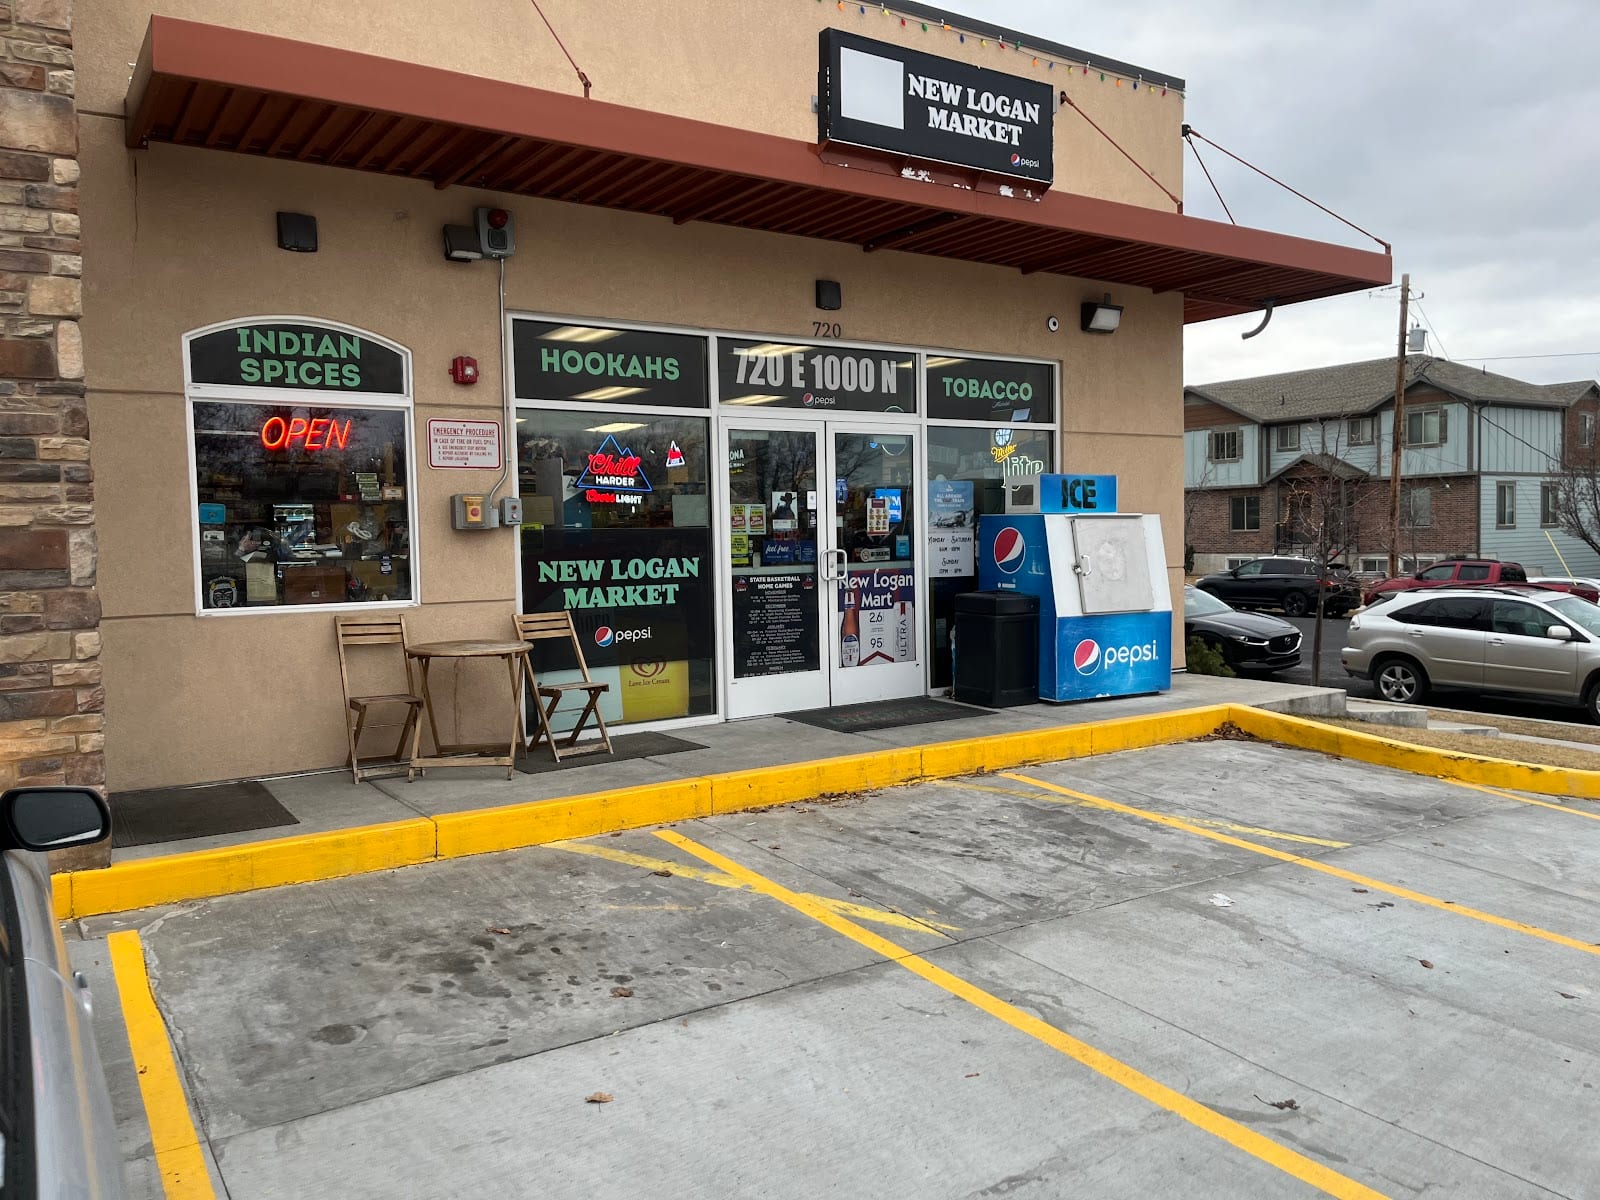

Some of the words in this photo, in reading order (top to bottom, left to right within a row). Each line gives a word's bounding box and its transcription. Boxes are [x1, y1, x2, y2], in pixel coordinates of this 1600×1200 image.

[908, 73, 963, 106] NEW
[966, 87, 1041, 125] LOGAN
[927, 106, 1023, 147] MARKET
[1020, 158, 1040, 169] pepsi
[812, 322, 842, 338] 720
[236, 327, 361, 360] INDIAN
[240, 357, 361, 388] SPICES
[541, 348, 680, 381] HOOKAHS
[733, 347, 785, 387] 720
[792, 352, 806, 389] E
[810, 354, 875, 393] 1000
[881, 359, 897, 394] N
[942, 377, 1033, 402] TOBACCO
[814, 396, 836, 406] pepsi
[261, 416, 351, 450] OPEN
[433, 427, 464, 436] EMERGENCY
[466, 428, 495, 437] PROCEDURE
[991, 443, 1017, 462] Miller
[588, 453, 641, 477] Chill
[595, 475, 635, 488] HARDER
[586, 489, 616, 503] Coors
[615, 493, 643, 505] LIGHT
[1061, 478, 1097, 510] ICE
[765, 544, 777, 555] feel
[776, 544, 790, 555] free
[538, 559, 606, 583] NEW
[610, 556, 700, 581] LOGAN
[838, 573, 870, 590] New
[873, 572, 914, 591] Logan
[562, 583, 680, 610] MARKET
[860, 591, 893, 608] Mart
[869, 612, 883, 623] 2.6
[615, 627, 652, 644] pepsi
[870, 637, 883, 649] 95
[1104, 639, 1157, 670] pepsi
